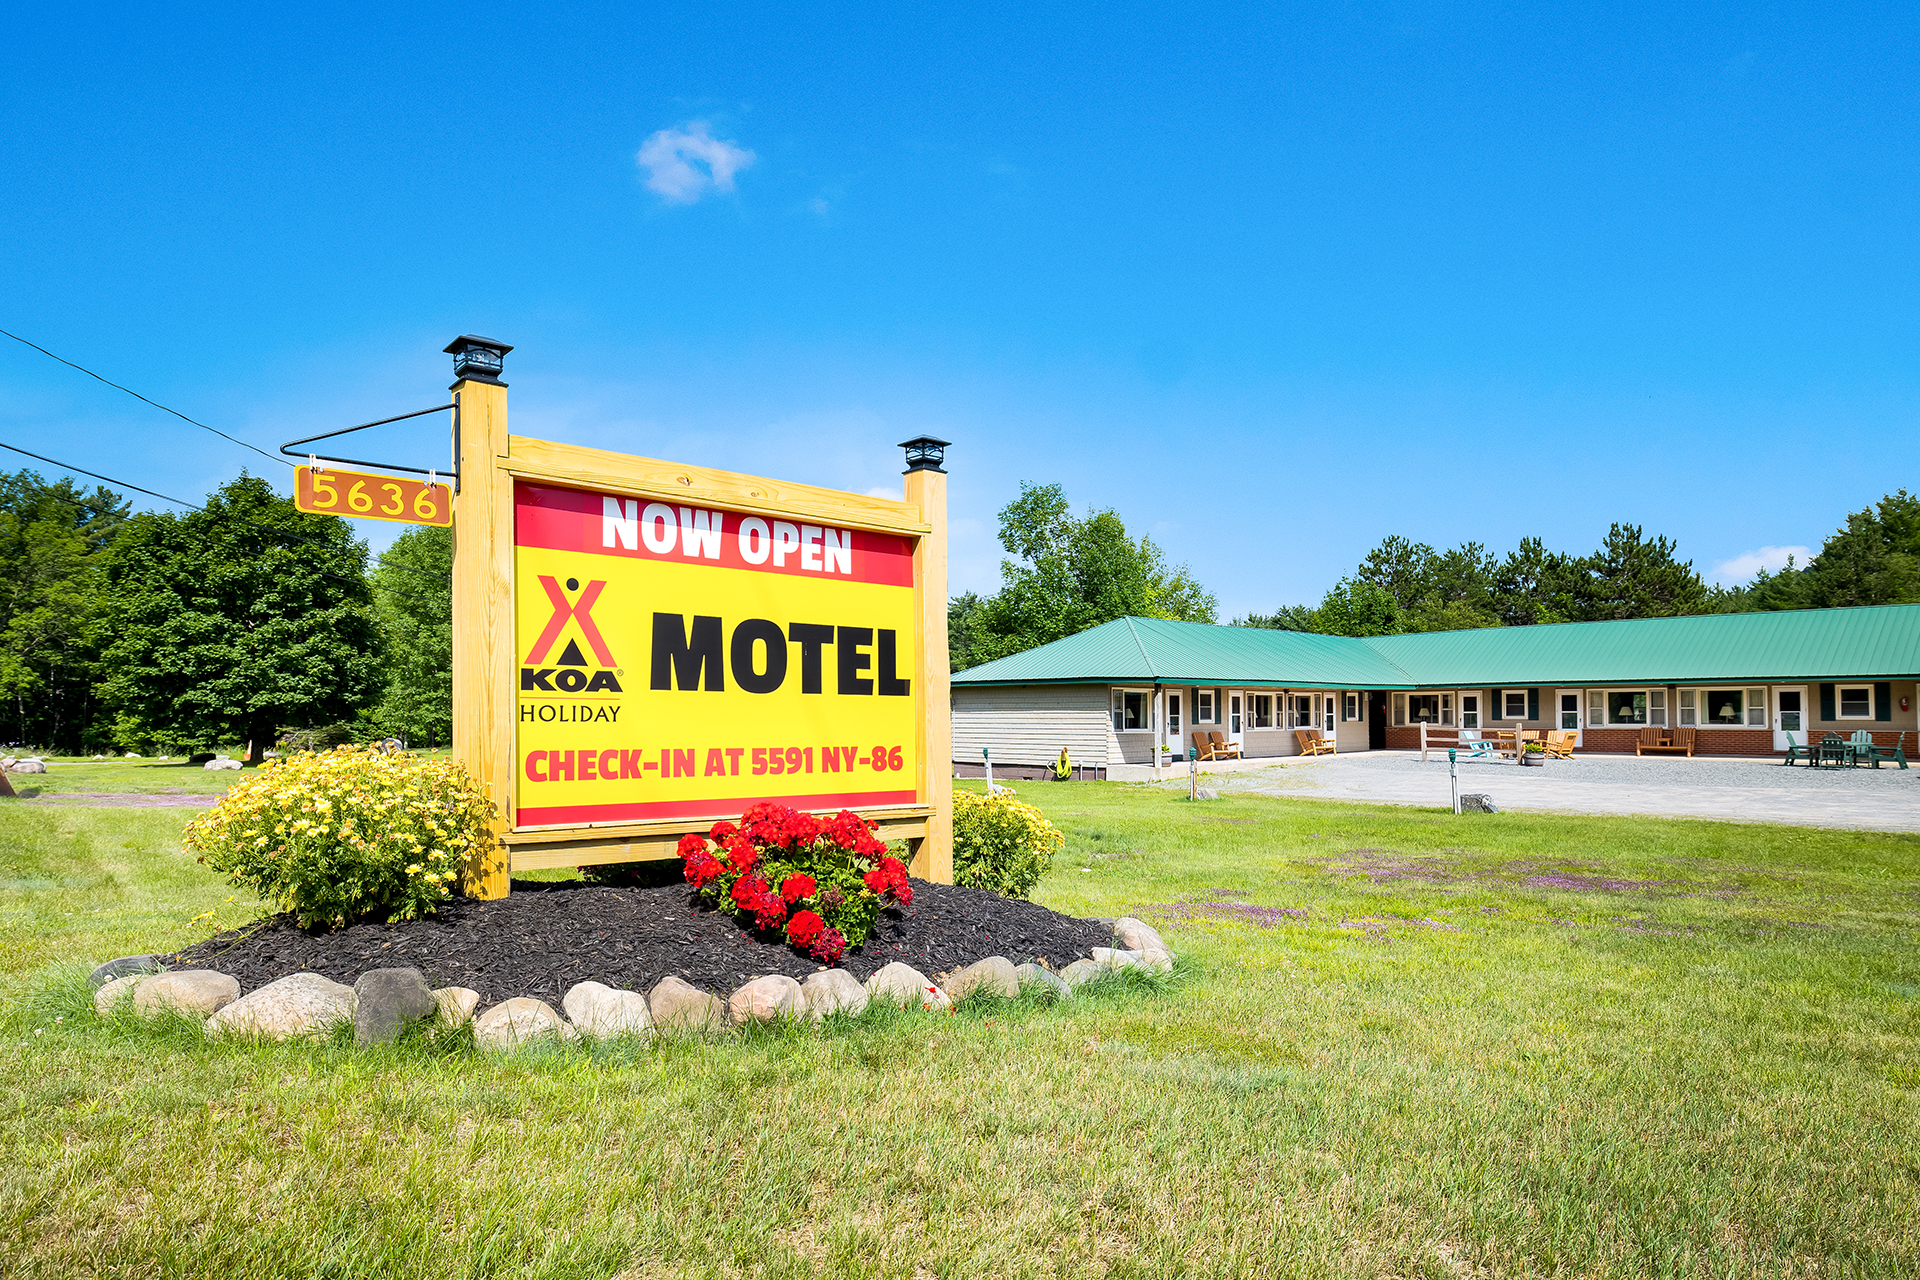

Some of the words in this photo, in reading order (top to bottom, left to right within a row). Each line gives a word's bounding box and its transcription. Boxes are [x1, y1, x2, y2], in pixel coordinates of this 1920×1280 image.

[312, 475, 437, 519] 5636
[602, 496, 723, 560] NOW
[738, 517, 852, 575] OPEN
[650, 612, 911, 697] MOTEL
[520, 705, 621, 722] HOLIDAY
[525, 749, 696, 782] CHECK-IN
[704, 748, 745, 776] AT
[752, 747, 813, 775] 5591
[821, 746, 903, 773] NY-86
